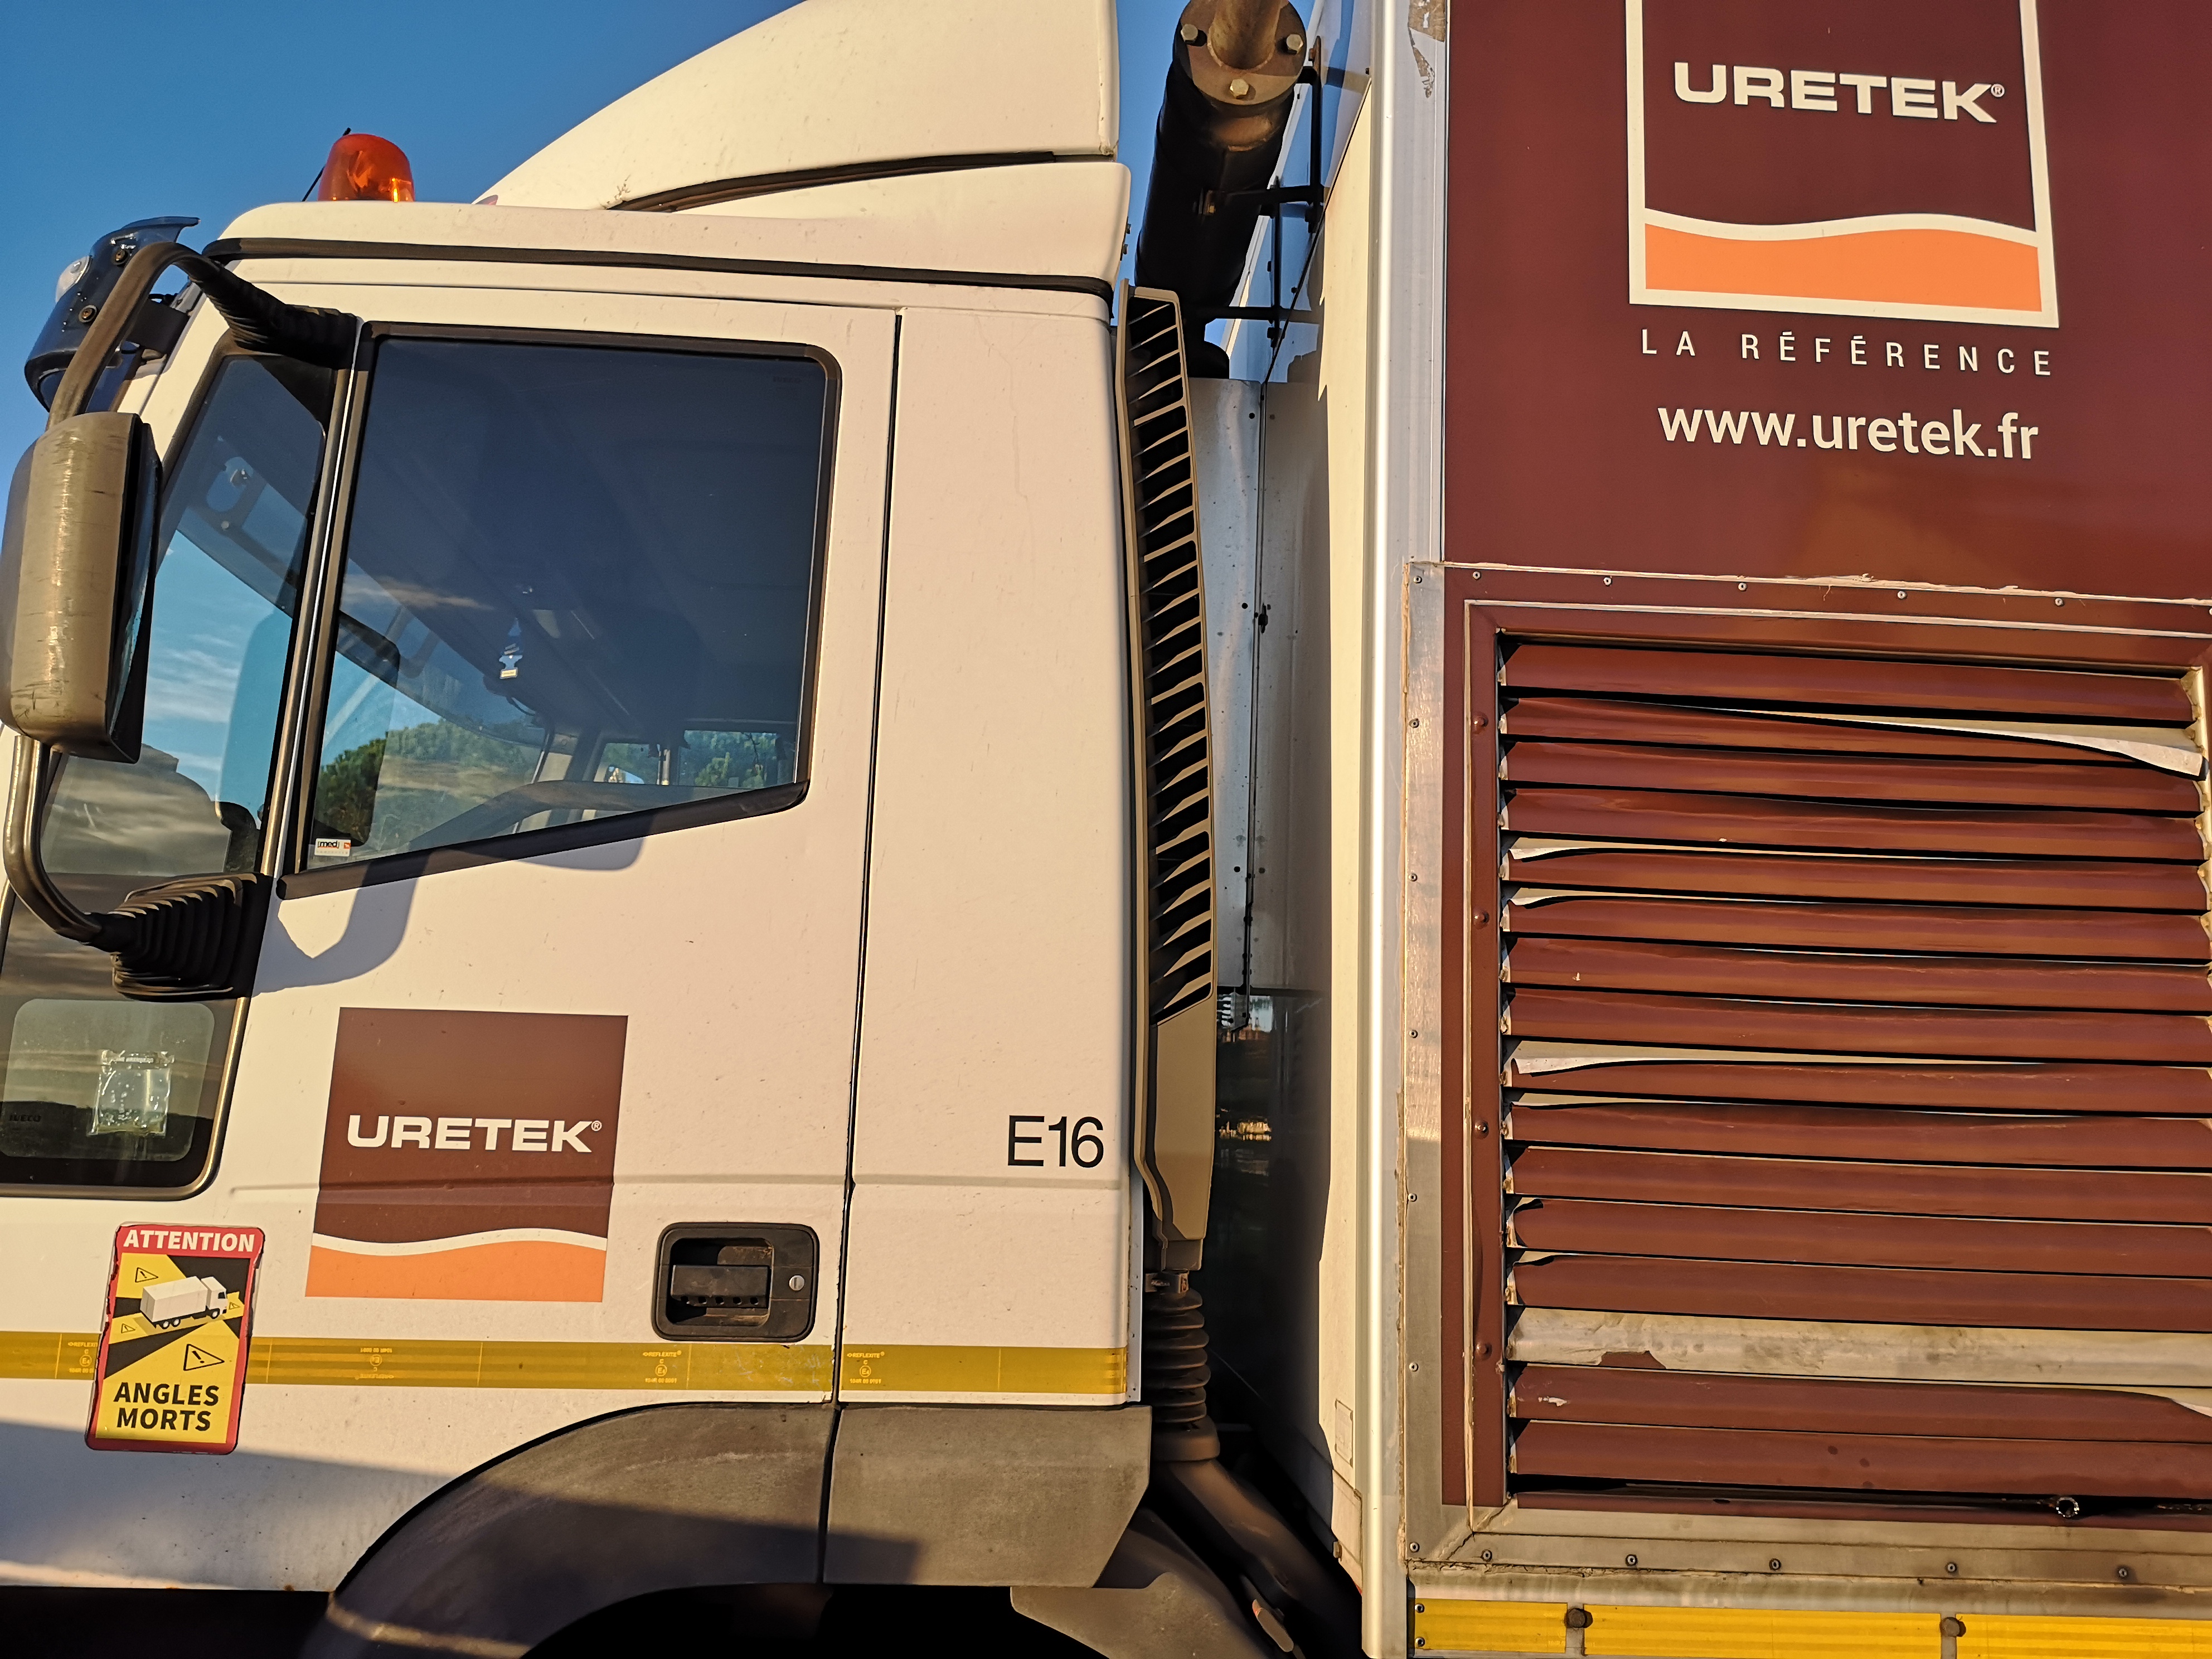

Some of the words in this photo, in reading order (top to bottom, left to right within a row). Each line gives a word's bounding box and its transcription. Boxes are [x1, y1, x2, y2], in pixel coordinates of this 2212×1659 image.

[1641, 328, 1695, 356] LA
[1742, 331, 2051, 376] RÉFÉRENCE
[1657, 407, 2039, 459] www.uretek.fr
[1007, 1115, 1104, 1168] E16
[123, 1229, 255, 1252] ATTENTION
[113, 1382, 220, 1406] ANGLES
[117, 1408, 211, 1432] MORTS
